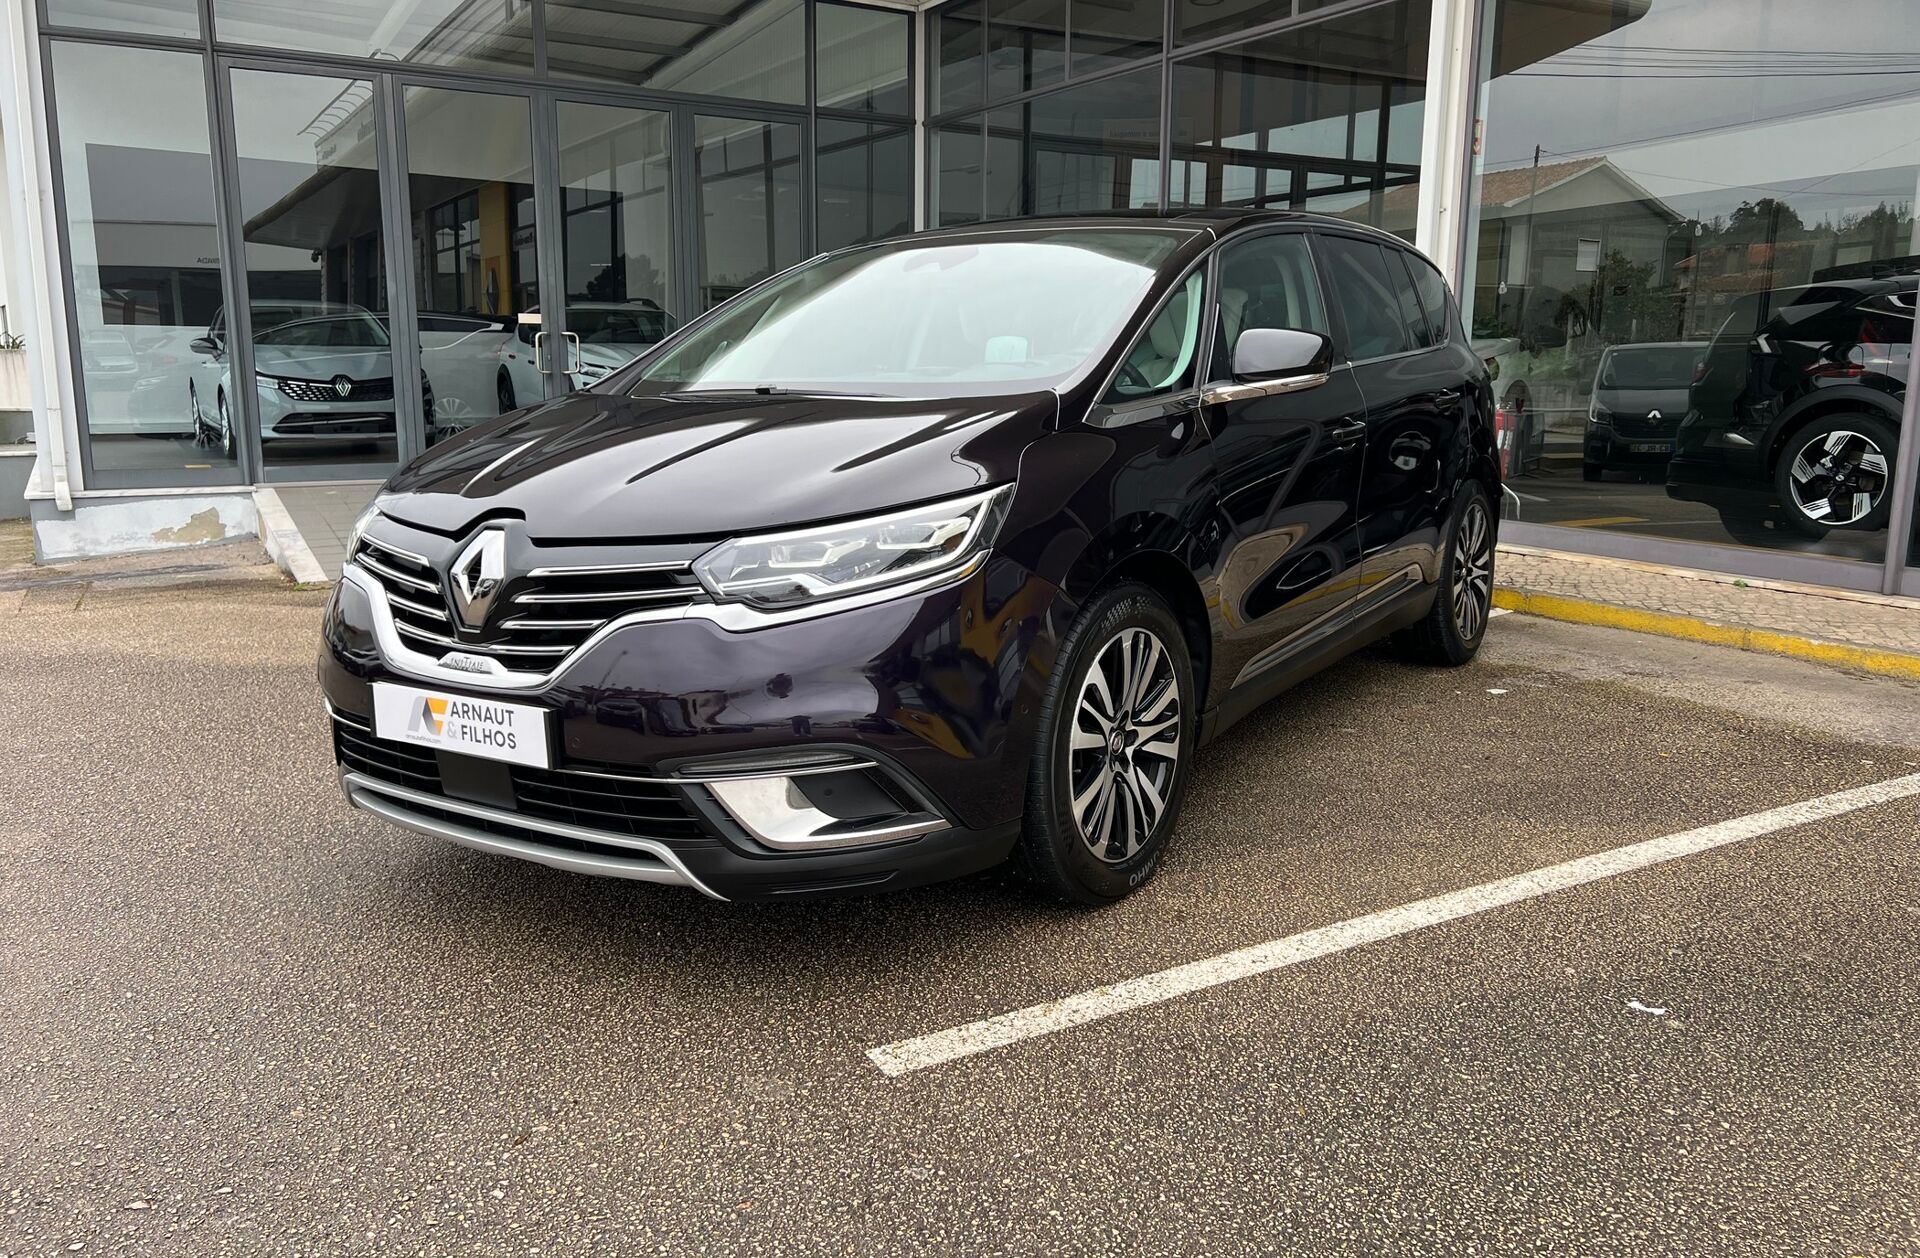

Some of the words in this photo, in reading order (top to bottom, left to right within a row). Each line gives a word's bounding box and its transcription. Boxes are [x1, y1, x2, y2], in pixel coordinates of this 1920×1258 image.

[451, 701, 514, 726] ARNAUT
[448, 722, 457, 739] &
[461, 725, 516, 749] FILHOS
